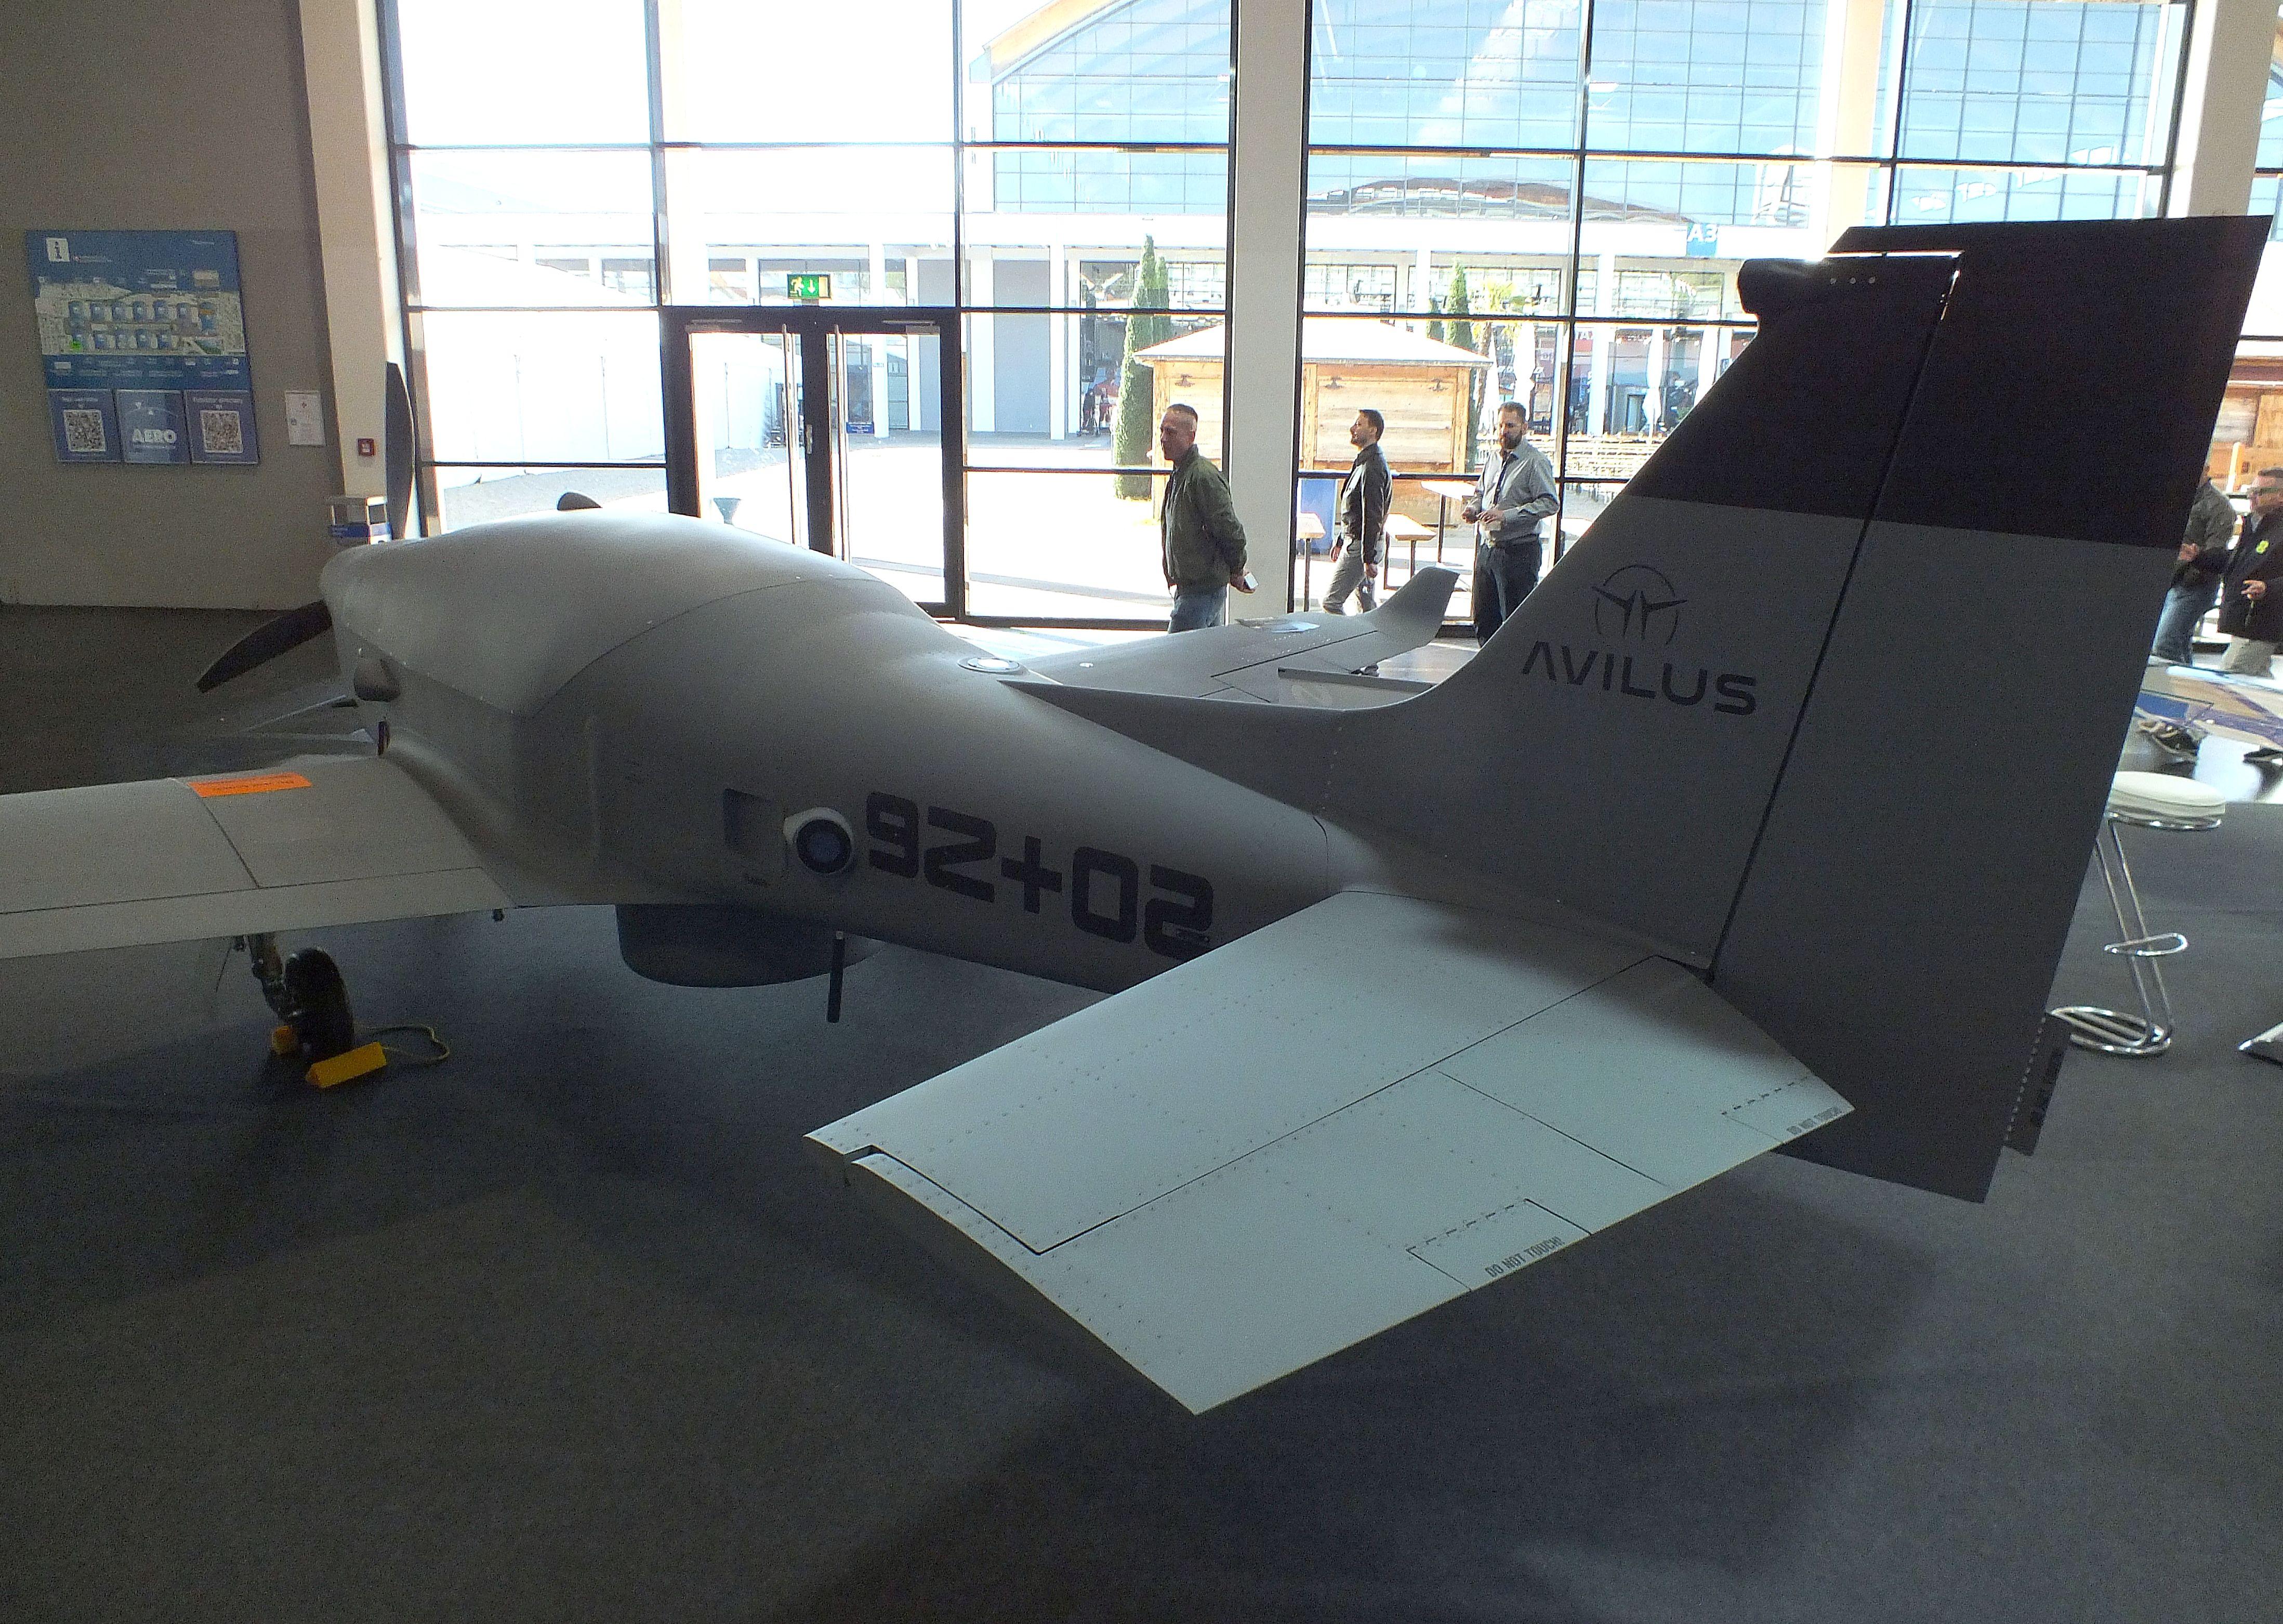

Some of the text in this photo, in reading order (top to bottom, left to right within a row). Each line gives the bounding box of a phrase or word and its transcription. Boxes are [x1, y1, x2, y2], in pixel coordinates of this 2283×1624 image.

[1687, 223, 1718, 242] A3
[1522, 641, 1756, 716] AVILUS
[1485, 1263, 1505, 1277] DO
[1501, 1253, 1527, 1269] NOT
